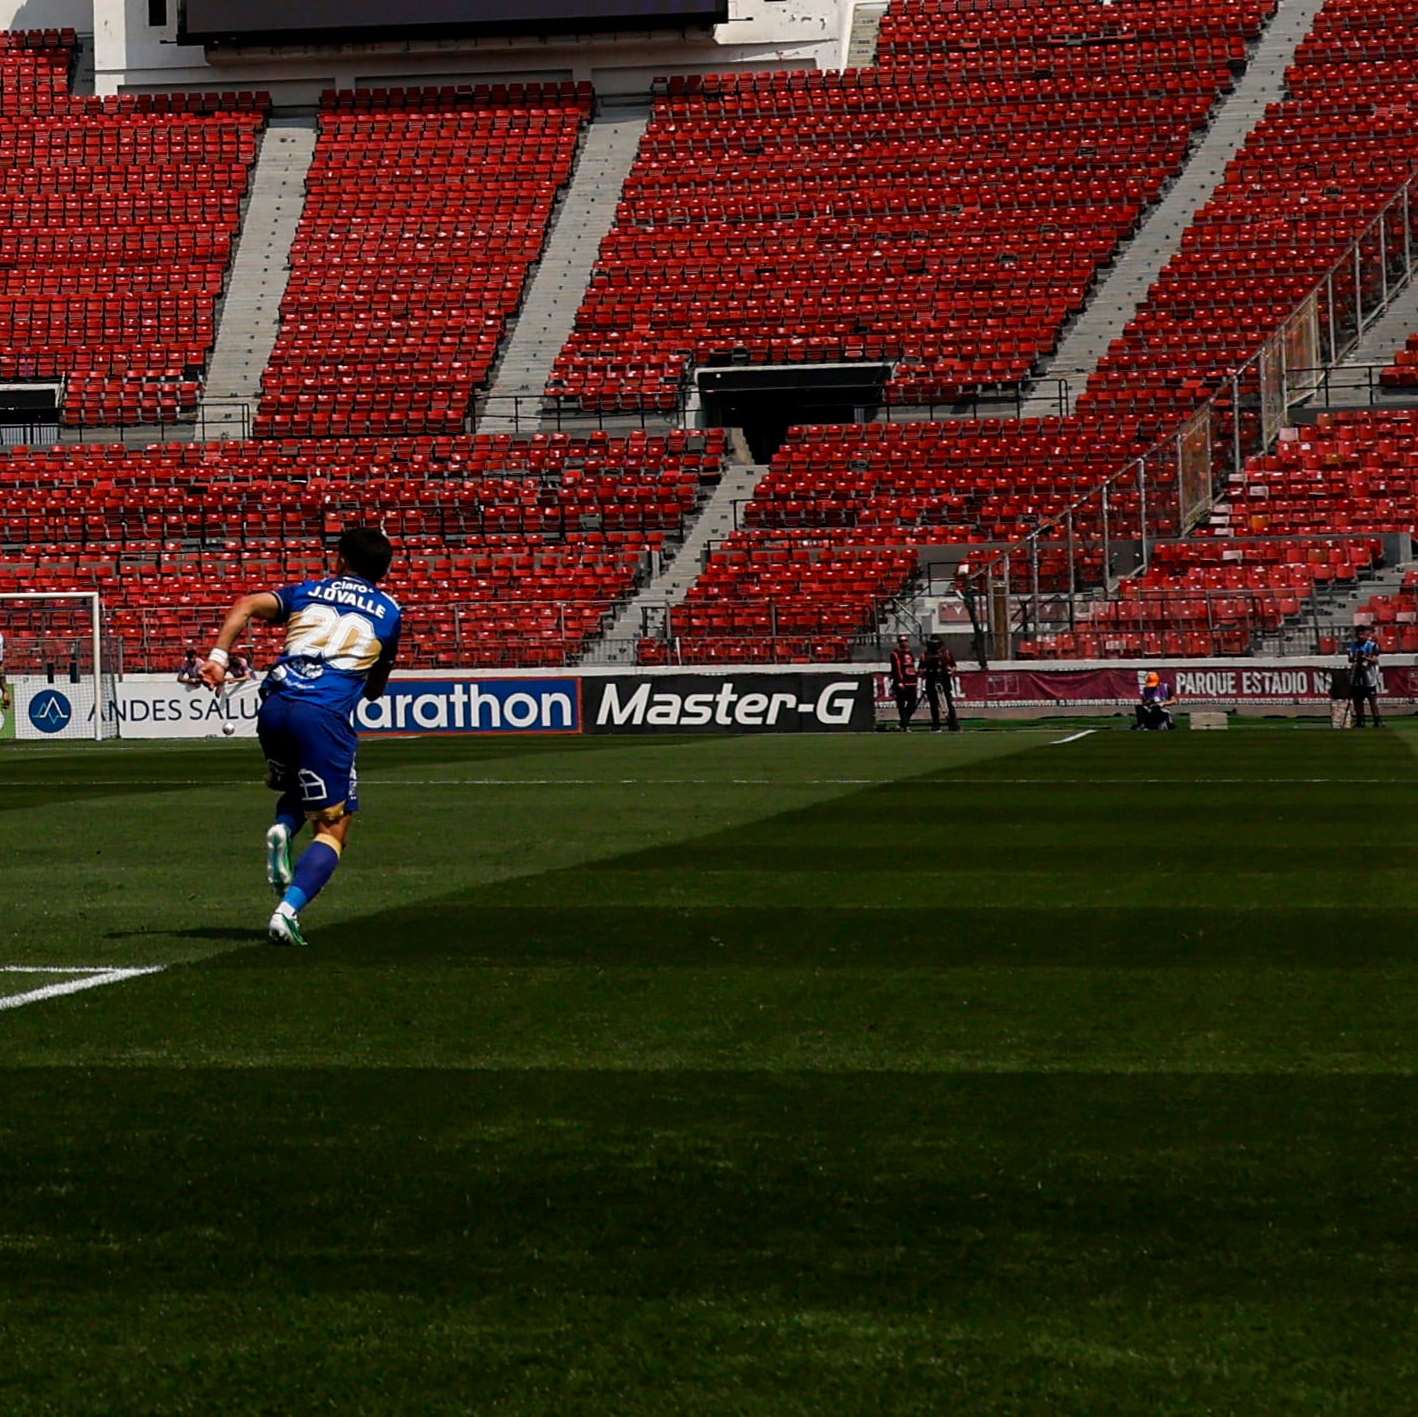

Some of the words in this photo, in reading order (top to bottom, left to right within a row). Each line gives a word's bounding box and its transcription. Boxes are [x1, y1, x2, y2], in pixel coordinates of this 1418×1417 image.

[308, 586, 386, 619] J.OVALLE
[331, 581, 367, 593] Claro
[287, 603, 376, 670] 20
[1175, 673, 1237, 695] PARQUE
[1242, 671, 1308, 695] ESTADIO
[88, 699, 182, 722] ANDES
[190, 698, 258, 720] SALU
[350, 683, 572, 729] arathon
[596, 681, 859, 725] Master-G
